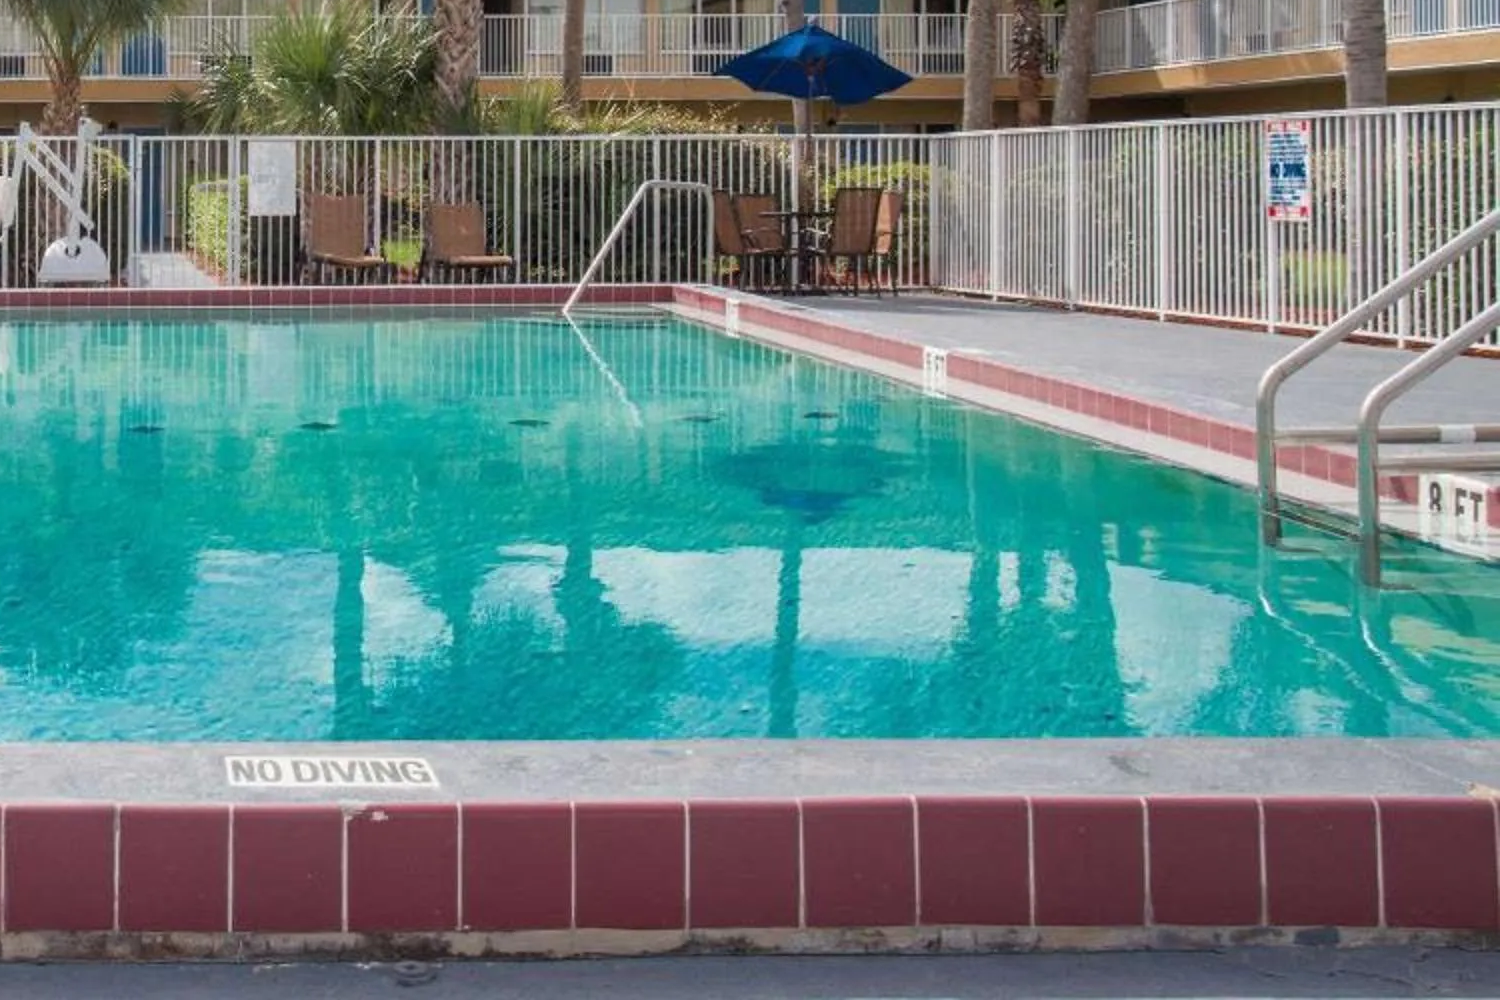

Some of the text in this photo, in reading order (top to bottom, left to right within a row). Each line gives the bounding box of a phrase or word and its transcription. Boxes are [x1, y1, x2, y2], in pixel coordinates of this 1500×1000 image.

[1429, 481, 1483, 522] 8 FT
[230, 759, 433, 784] NO DIVING
